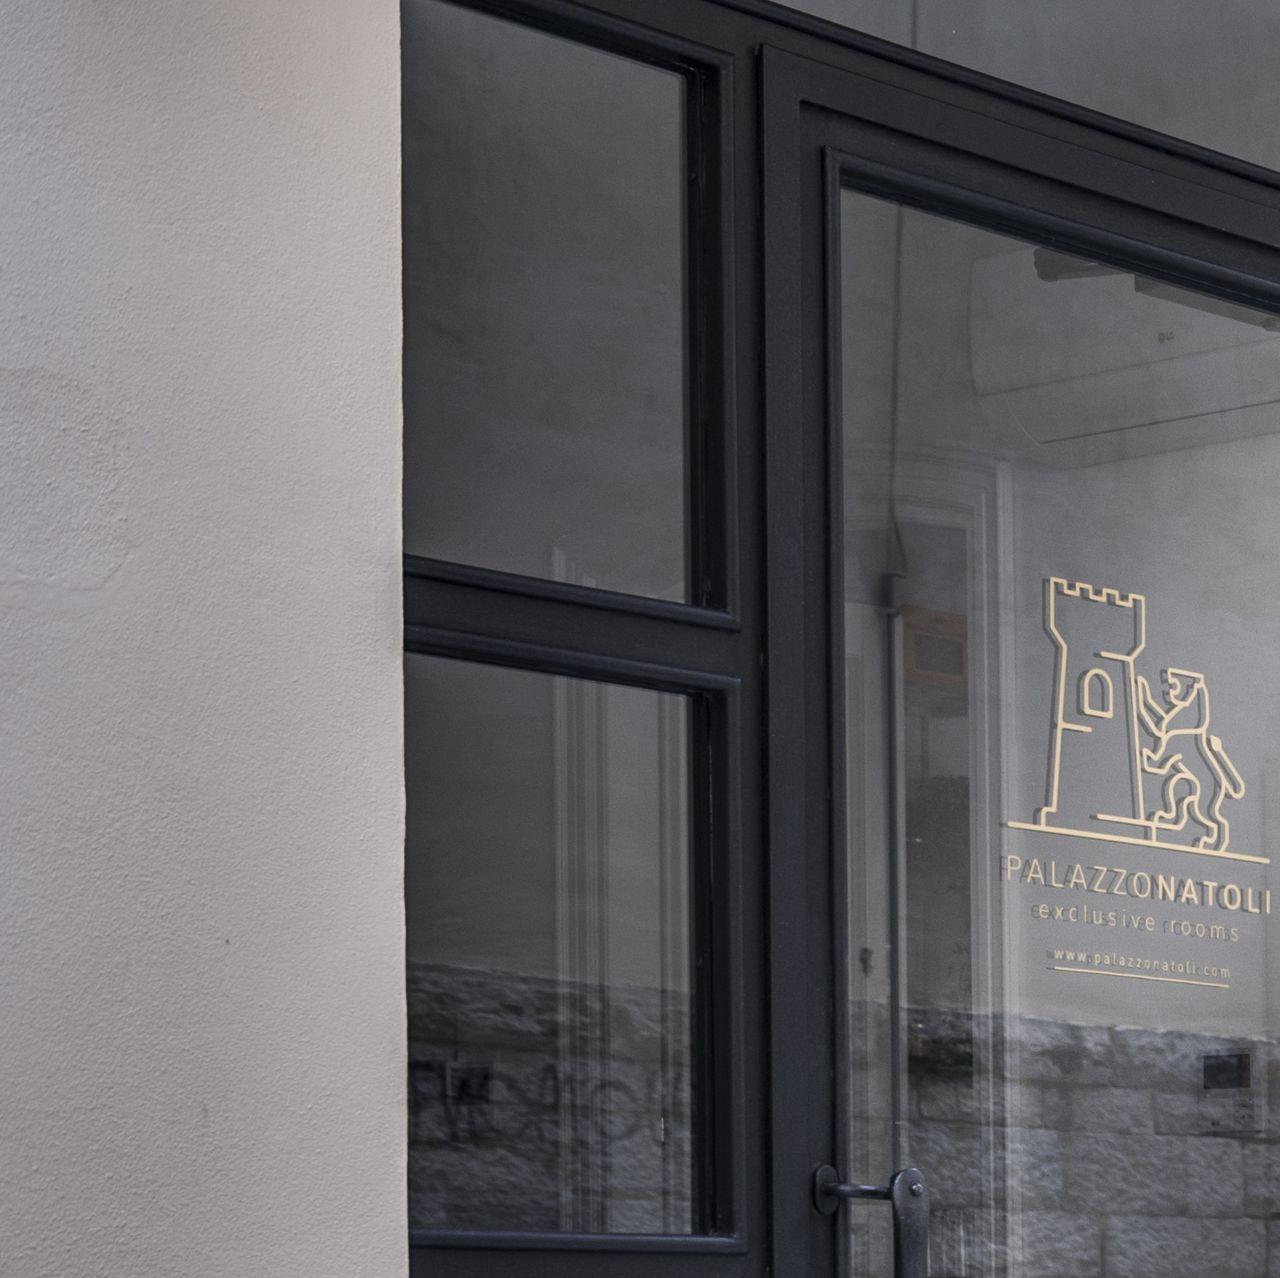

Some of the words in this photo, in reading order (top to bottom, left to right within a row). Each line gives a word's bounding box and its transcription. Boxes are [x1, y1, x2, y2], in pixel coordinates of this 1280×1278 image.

[1007, 854, 1271, 914] PALAZZONATOLI
[1038, 903, 1155, 932] exclusive
[1170, 919, 1239, 942] rooms
[1053, 950, 1231, 978] www.palazzonatoli.com
